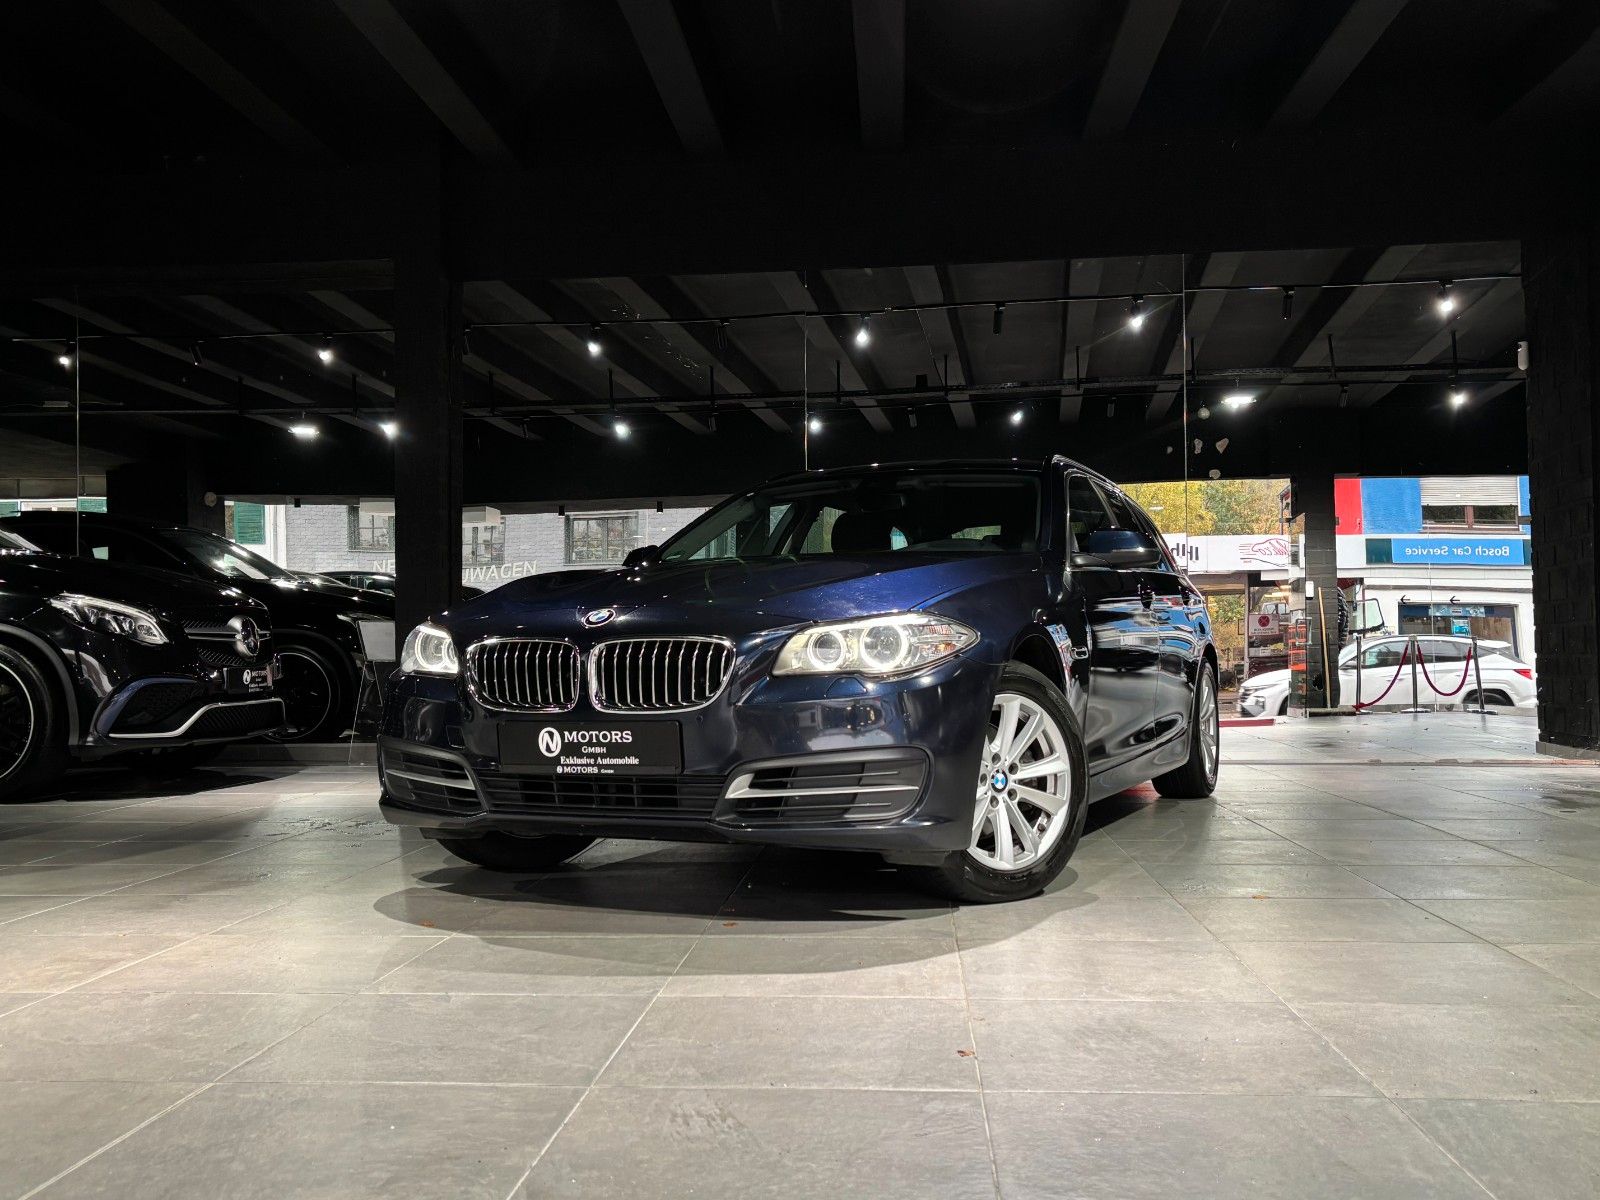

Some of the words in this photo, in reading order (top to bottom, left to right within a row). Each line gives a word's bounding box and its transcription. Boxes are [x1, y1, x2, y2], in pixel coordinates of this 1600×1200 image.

[563, 730, 633, 743] MOTORS
[560, 755, 595, 765] Exklusive
[596, 755, 640, 765] Automobile
[563, 766, 598, 774] MOTORS
